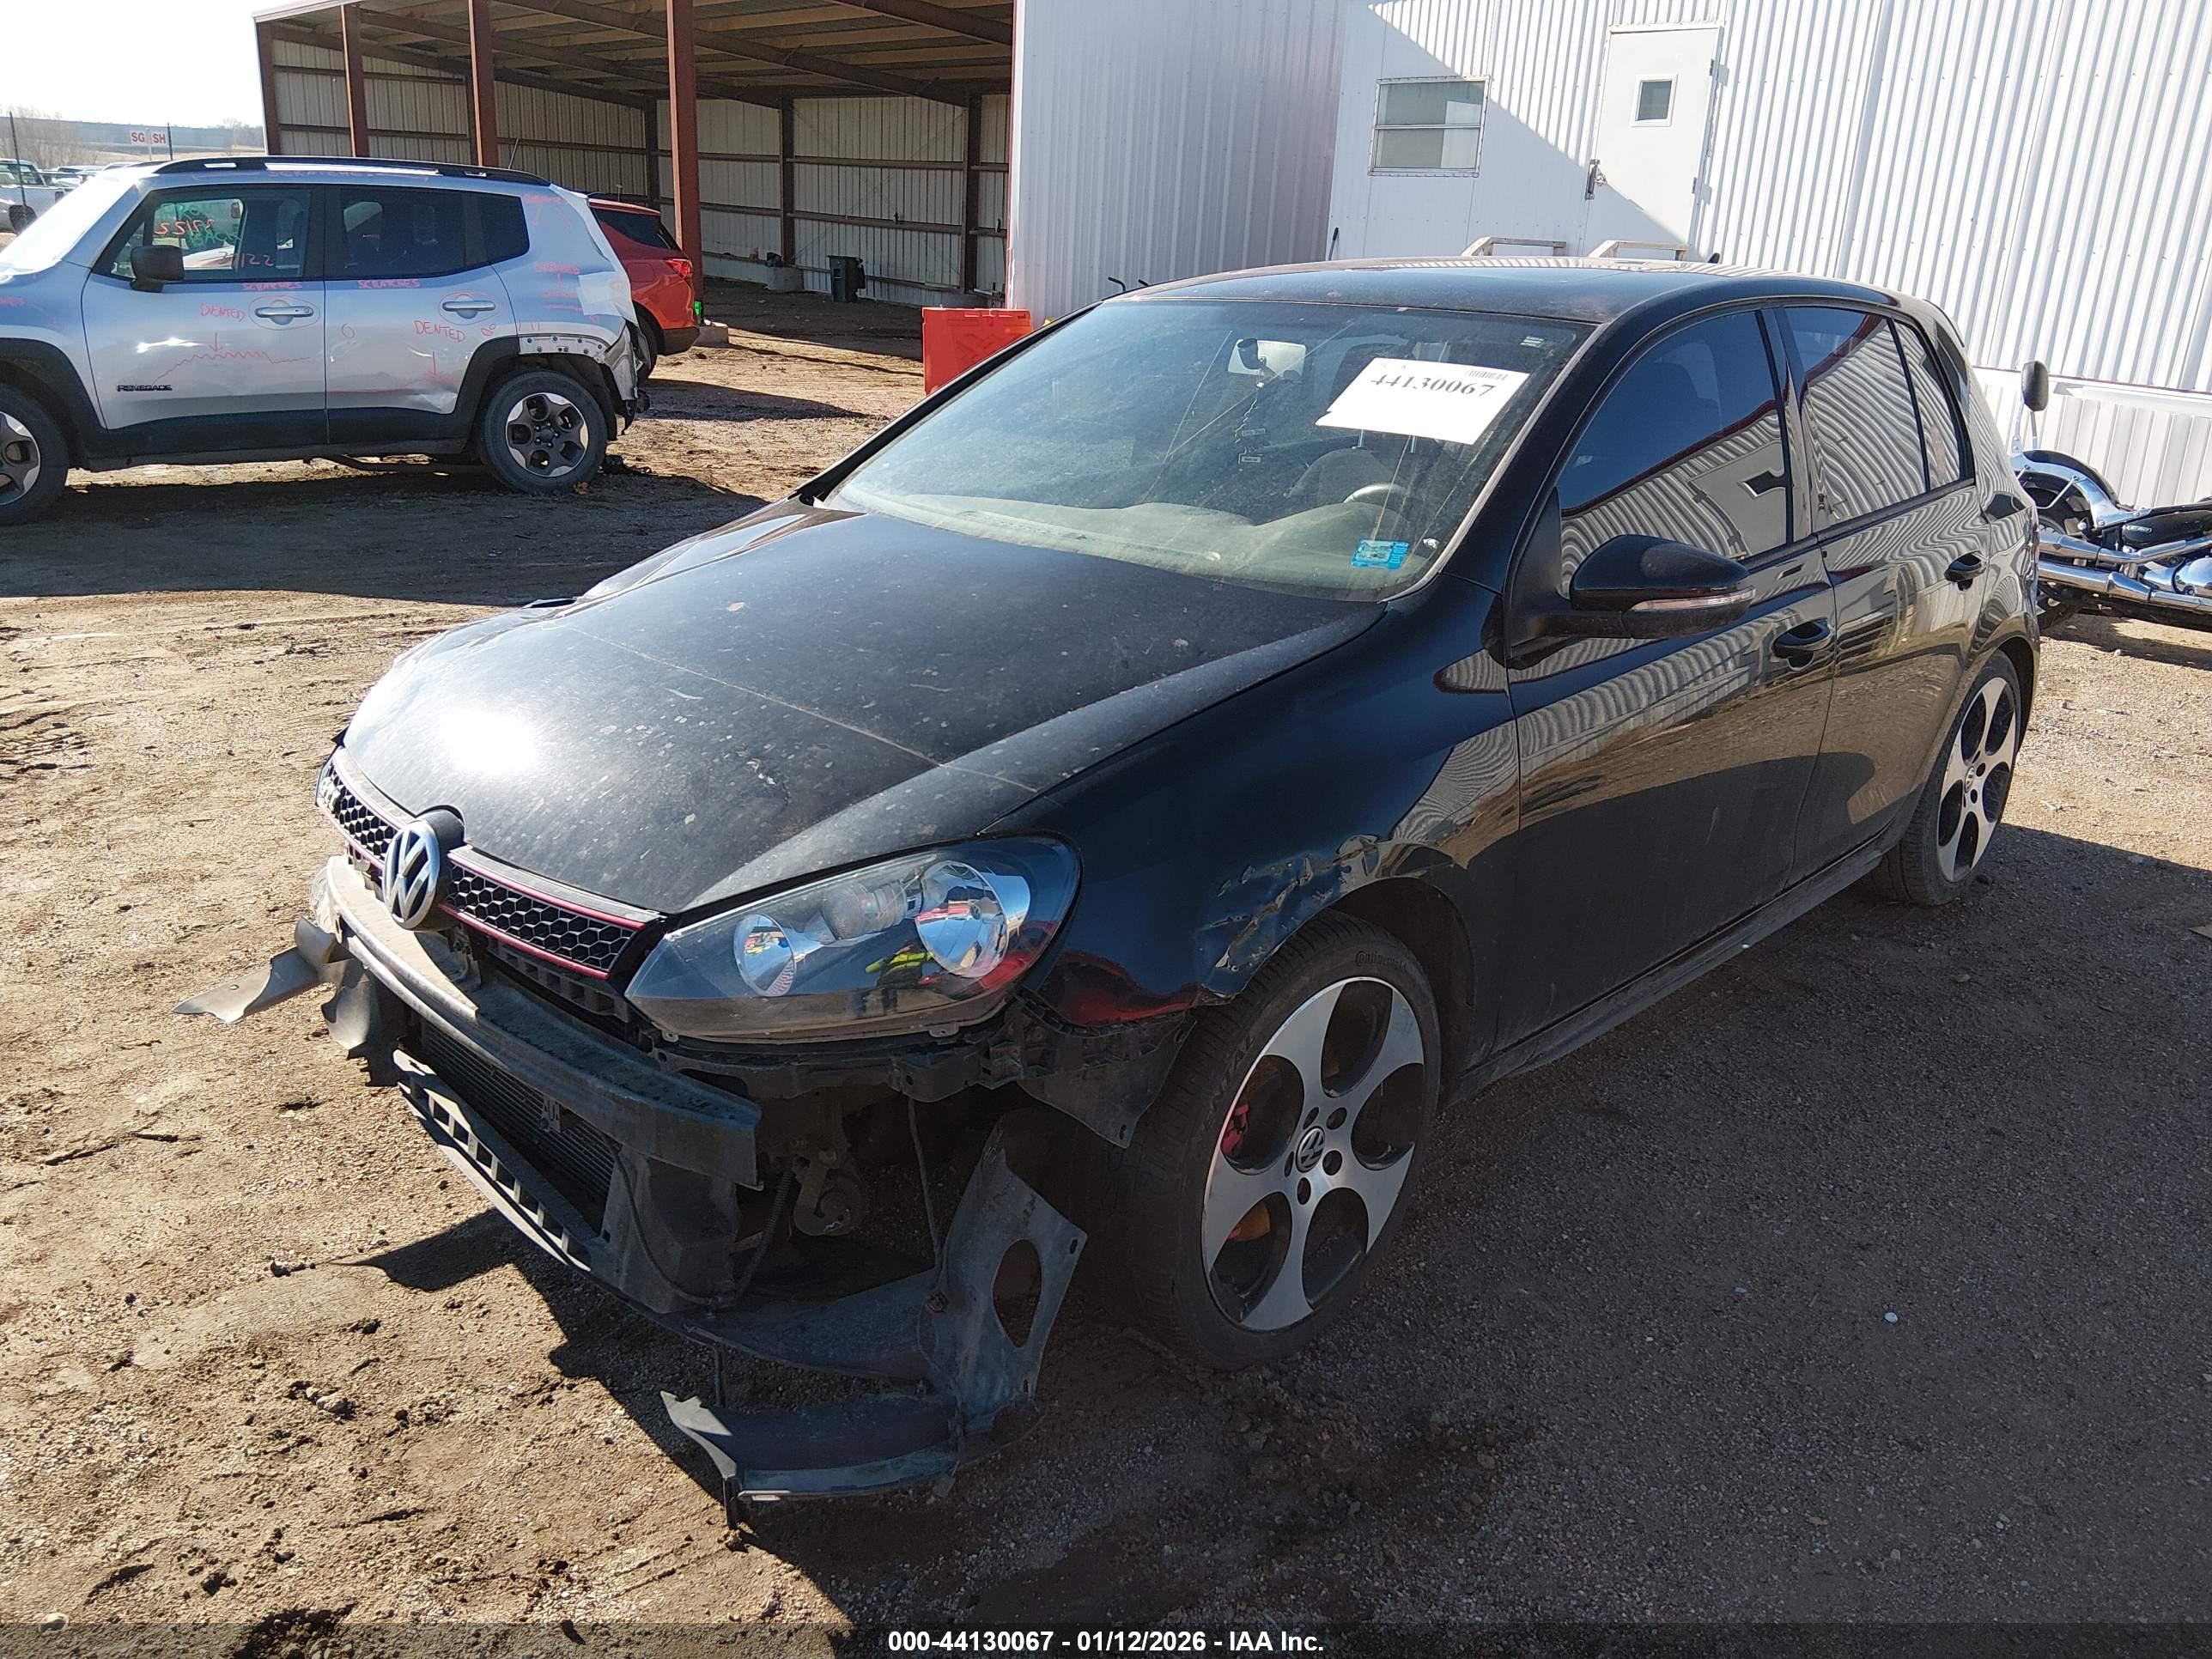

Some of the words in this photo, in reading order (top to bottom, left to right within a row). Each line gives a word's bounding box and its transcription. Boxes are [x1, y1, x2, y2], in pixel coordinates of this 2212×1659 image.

[131, 132, 145, 143] SG
[152, 133, 167, 144] SH
[413, 320, 466, 343] DENTED
[1370, 374, 1498, 397] 44130067
